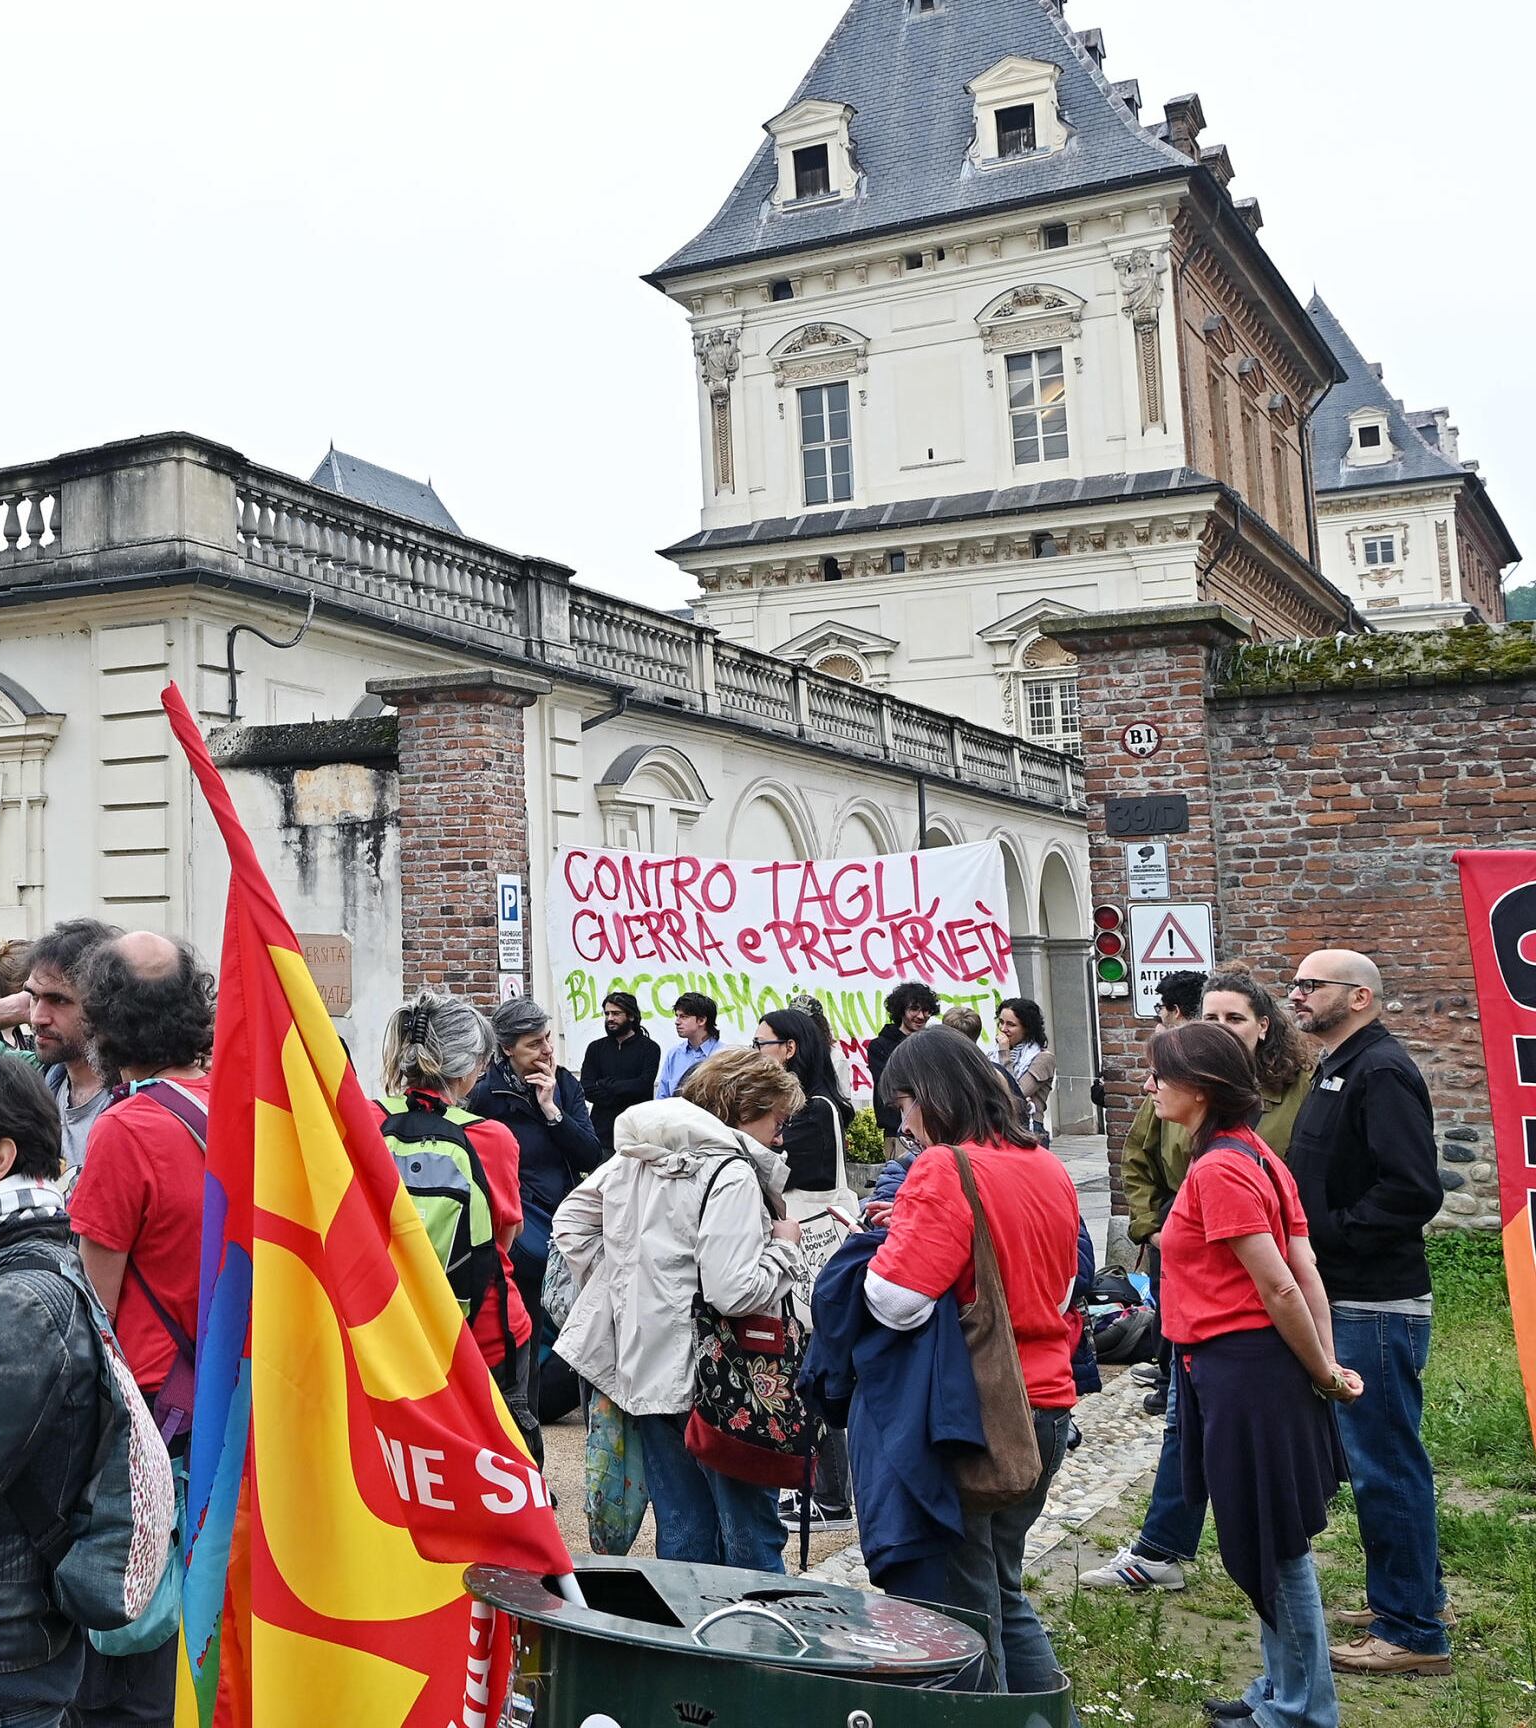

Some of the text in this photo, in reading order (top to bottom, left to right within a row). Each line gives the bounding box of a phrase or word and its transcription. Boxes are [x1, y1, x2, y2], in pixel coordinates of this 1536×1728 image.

[564, 851, 737, 913] CONTRO
[504, 887, 516, 919] P
[305, 945, 345, 963] ERSITÀ
[572, 900, 1012, 984] GUERRA e PRECARIETÀ
[318, 984, 350, 1005] ZIATE
[801, 1228, 833, 1244] FEMINIST
[374, 1425, 552, 1514] NE SI
